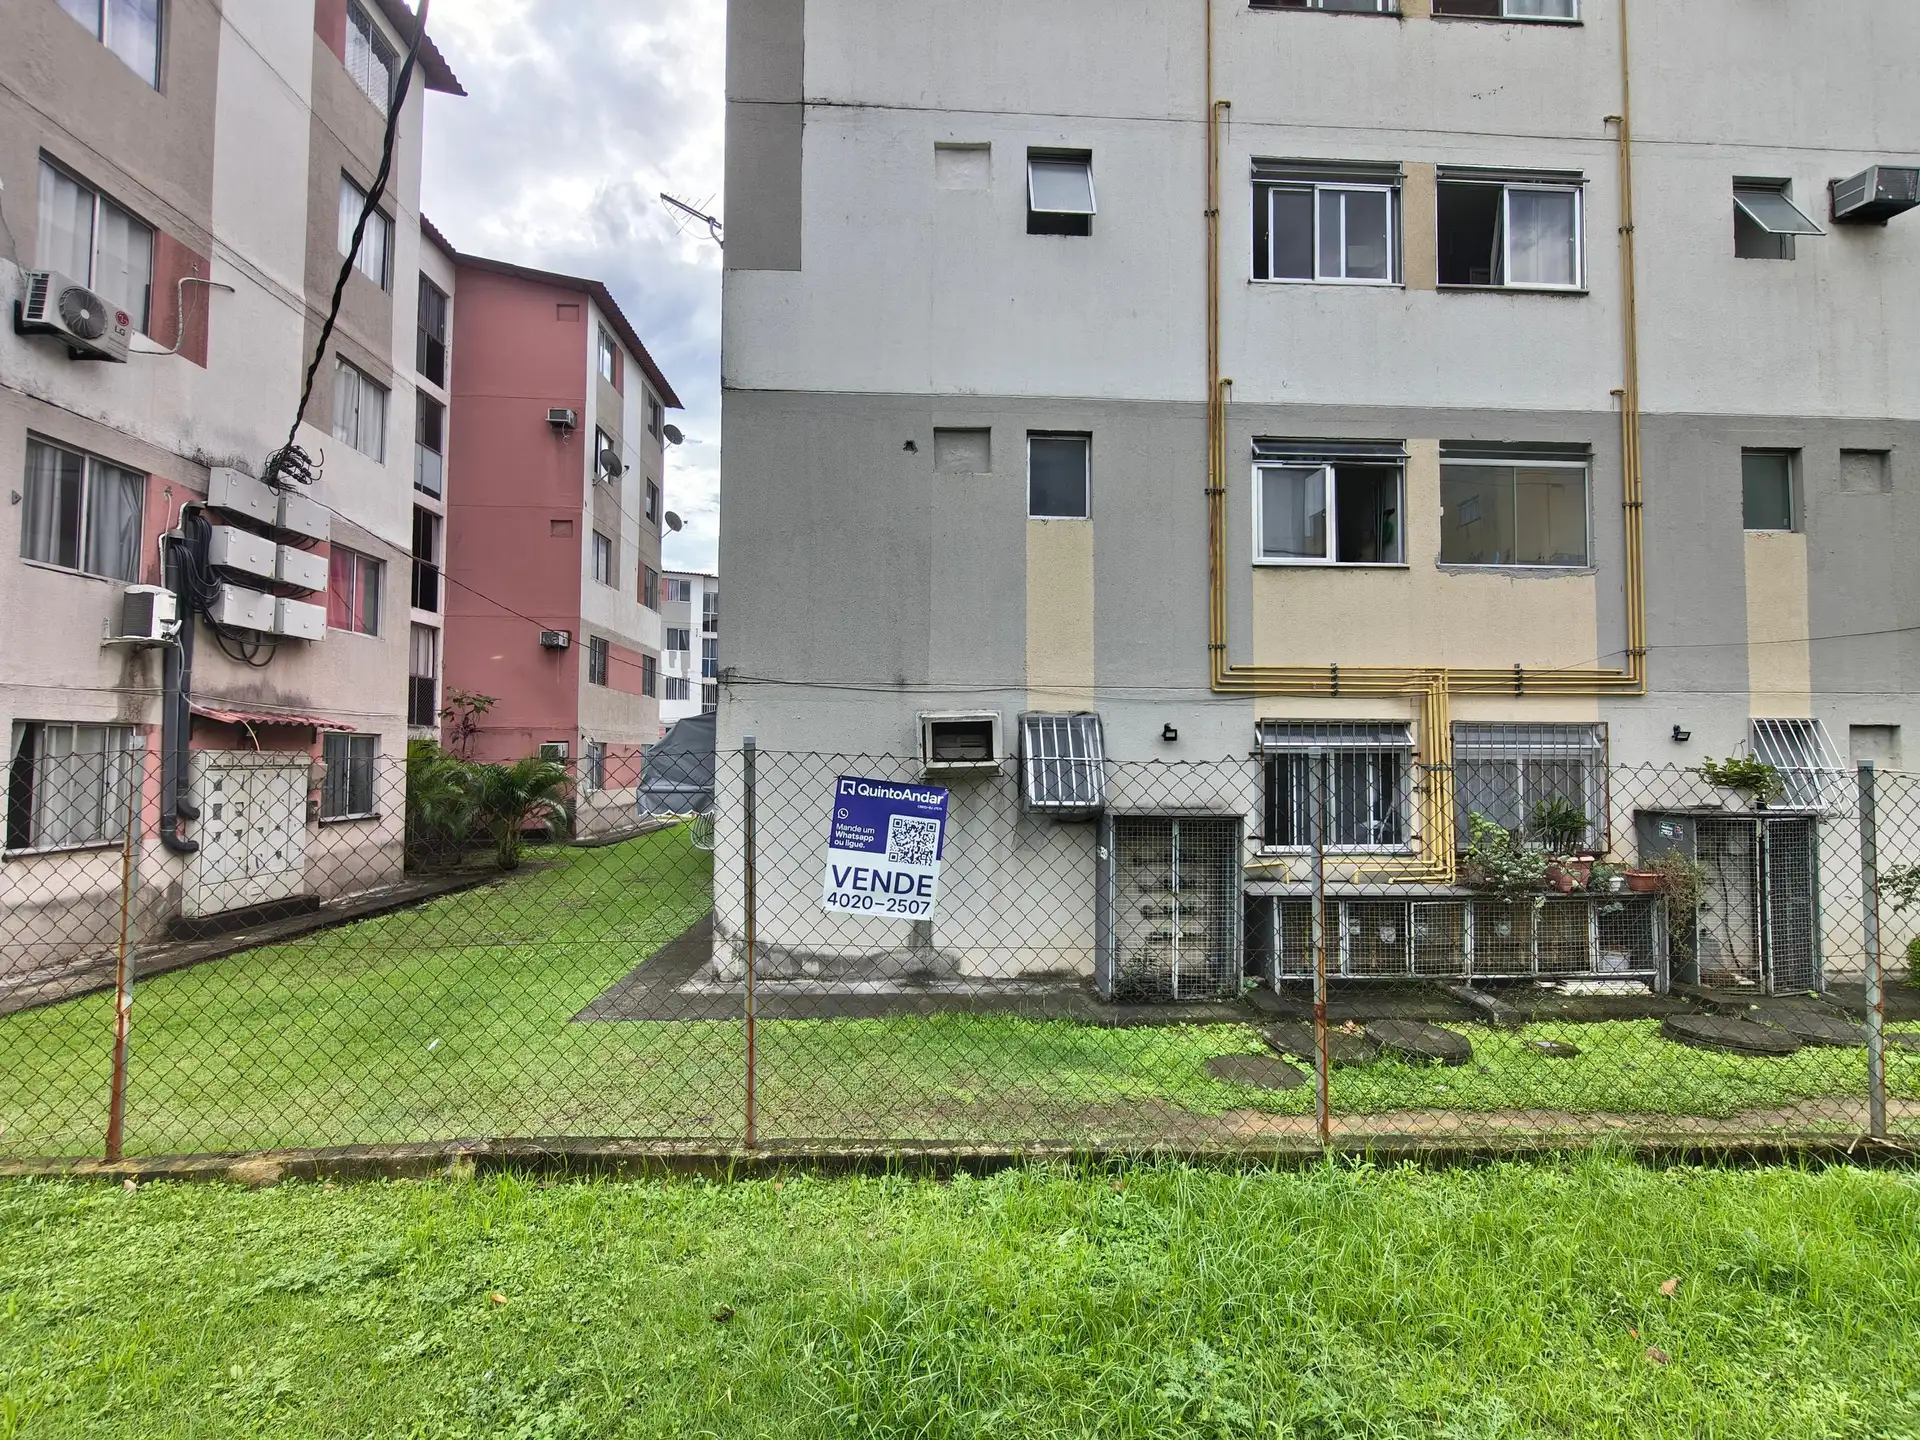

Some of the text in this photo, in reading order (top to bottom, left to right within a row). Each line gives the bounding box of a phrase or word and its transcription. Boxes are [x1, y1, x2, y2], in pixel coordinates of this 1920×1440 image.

[115, 325, 126, 337] LG
[858, 783, 944, 805] QuintoAndar
[836, 823, 862, 833] Mande
[835, 830, 875, 842] Whatsapp
[845, 839, 866, 849] ligue.
[832, 864, 934, 898] VENDE
[827, 892, 931, 915] 4020-2507
